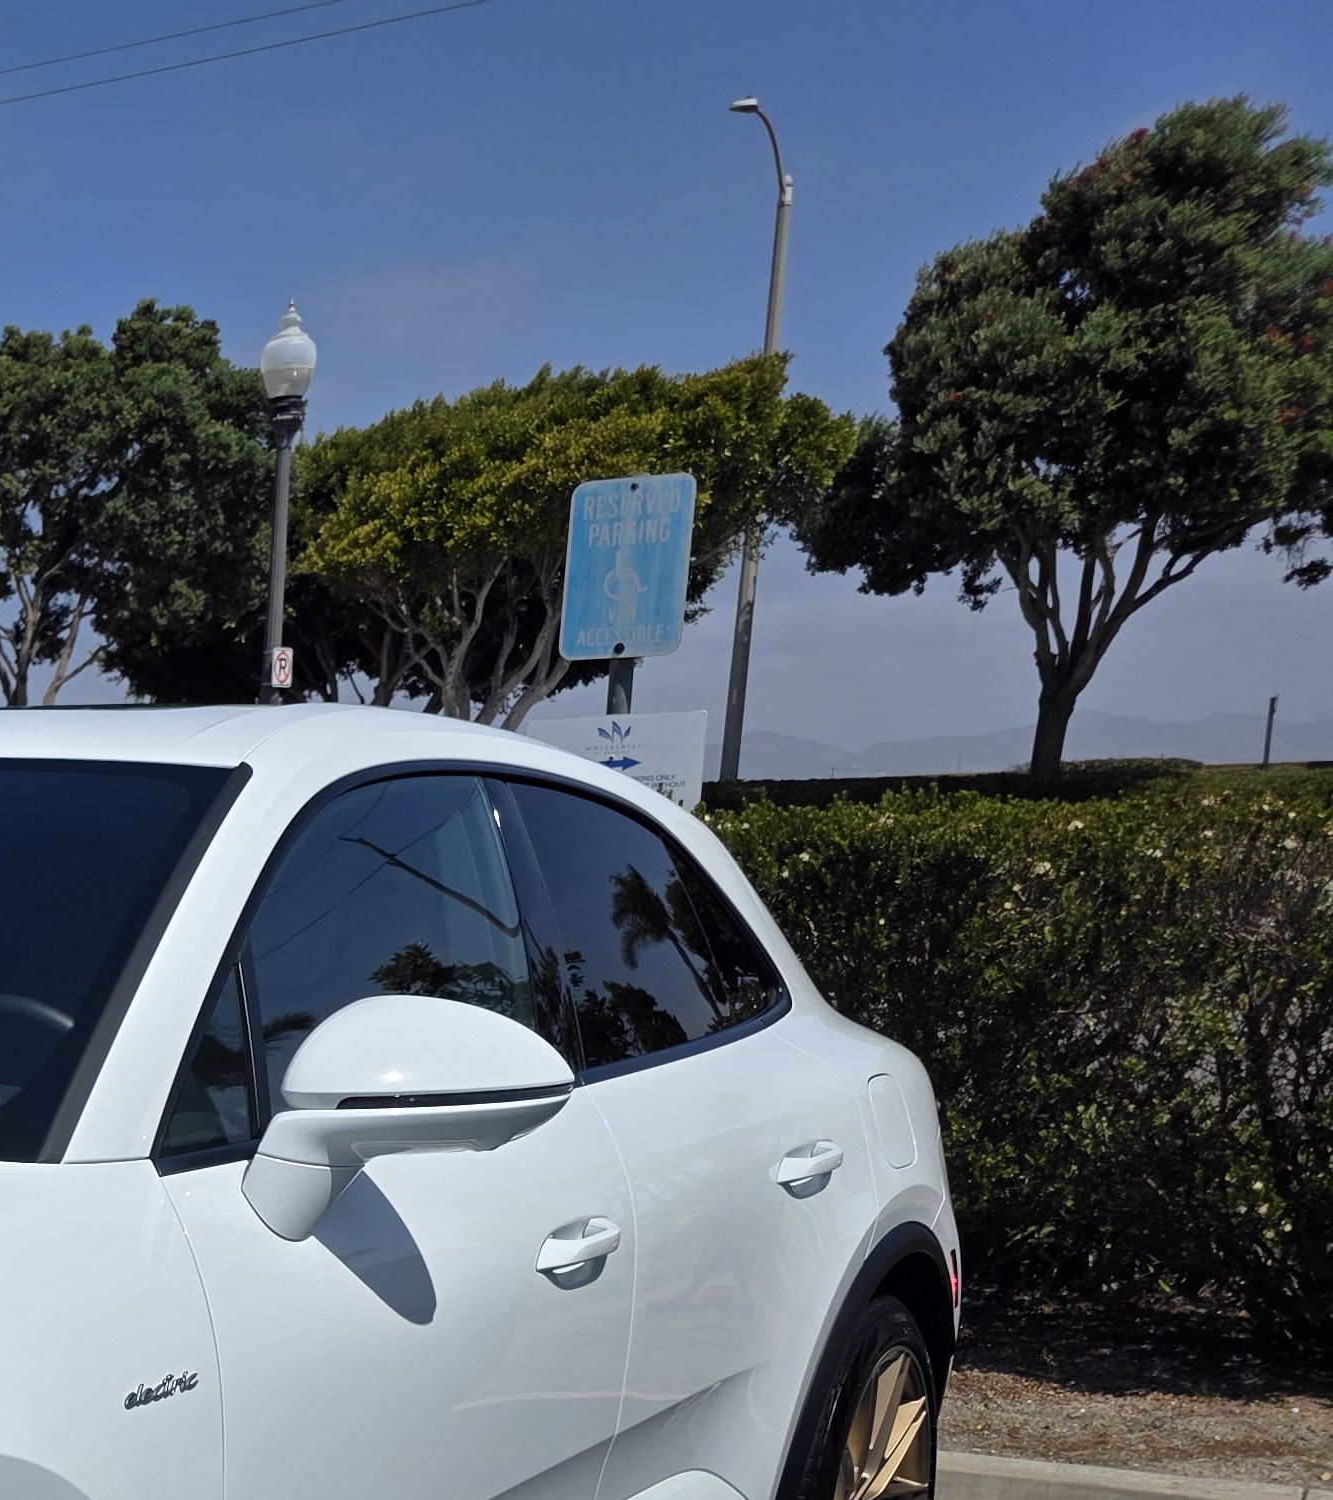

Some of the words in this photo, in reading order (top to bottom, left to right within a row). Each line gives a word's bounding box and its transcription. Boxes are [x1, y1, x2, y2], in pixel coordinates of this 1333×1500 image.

[583, 488, 681, 521] RESERVED
[588, 517, 671, 548] PARKING
[576, 623, 664, 647] ACCESSIBLE
[655, 773, 676, 781] ONLY
[124, 1370, 199, 1410] electric
